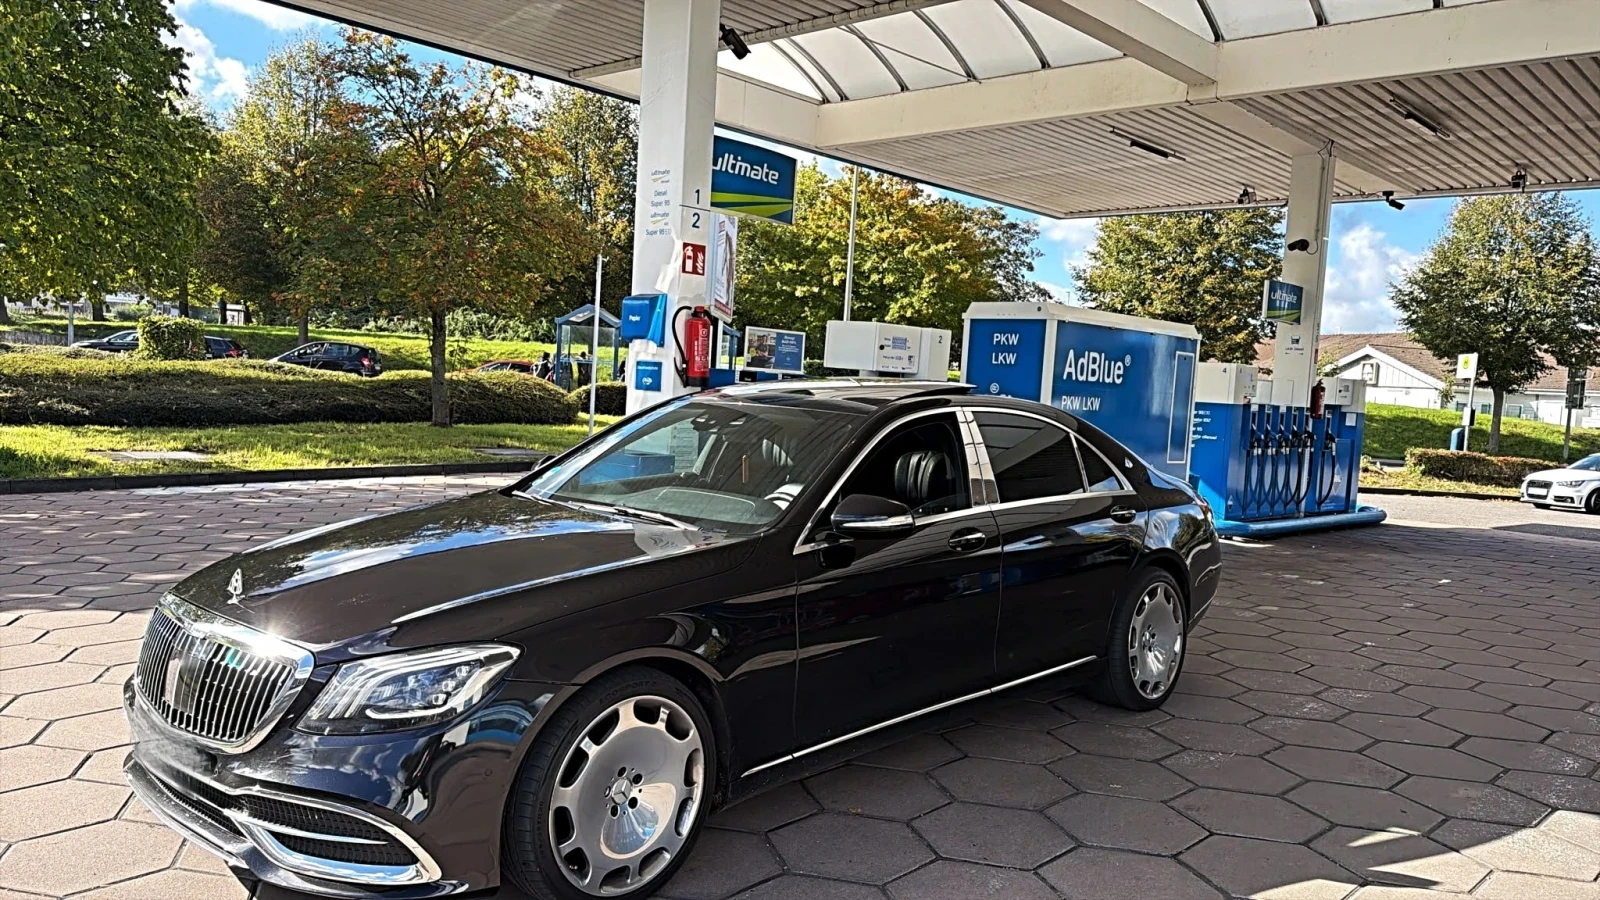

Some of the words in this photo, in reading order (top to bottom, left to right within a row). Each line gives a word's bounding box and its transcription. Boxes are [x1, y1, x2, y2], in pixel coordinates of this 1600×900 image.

[695, 189, 700, 205] 1
[651, 200, 663, 208] Super
[692, 212, 700, 229] 2
[1271, 289, 1297, 303] ultimate
[938, 335, 943, 344] 2
[993, 333, 1019, 346] PKW
[992, 352, 1017, 365] LKW
[1061, 396, 1081, 410] PKW
[1082, 397, 1101, 411] LKW
